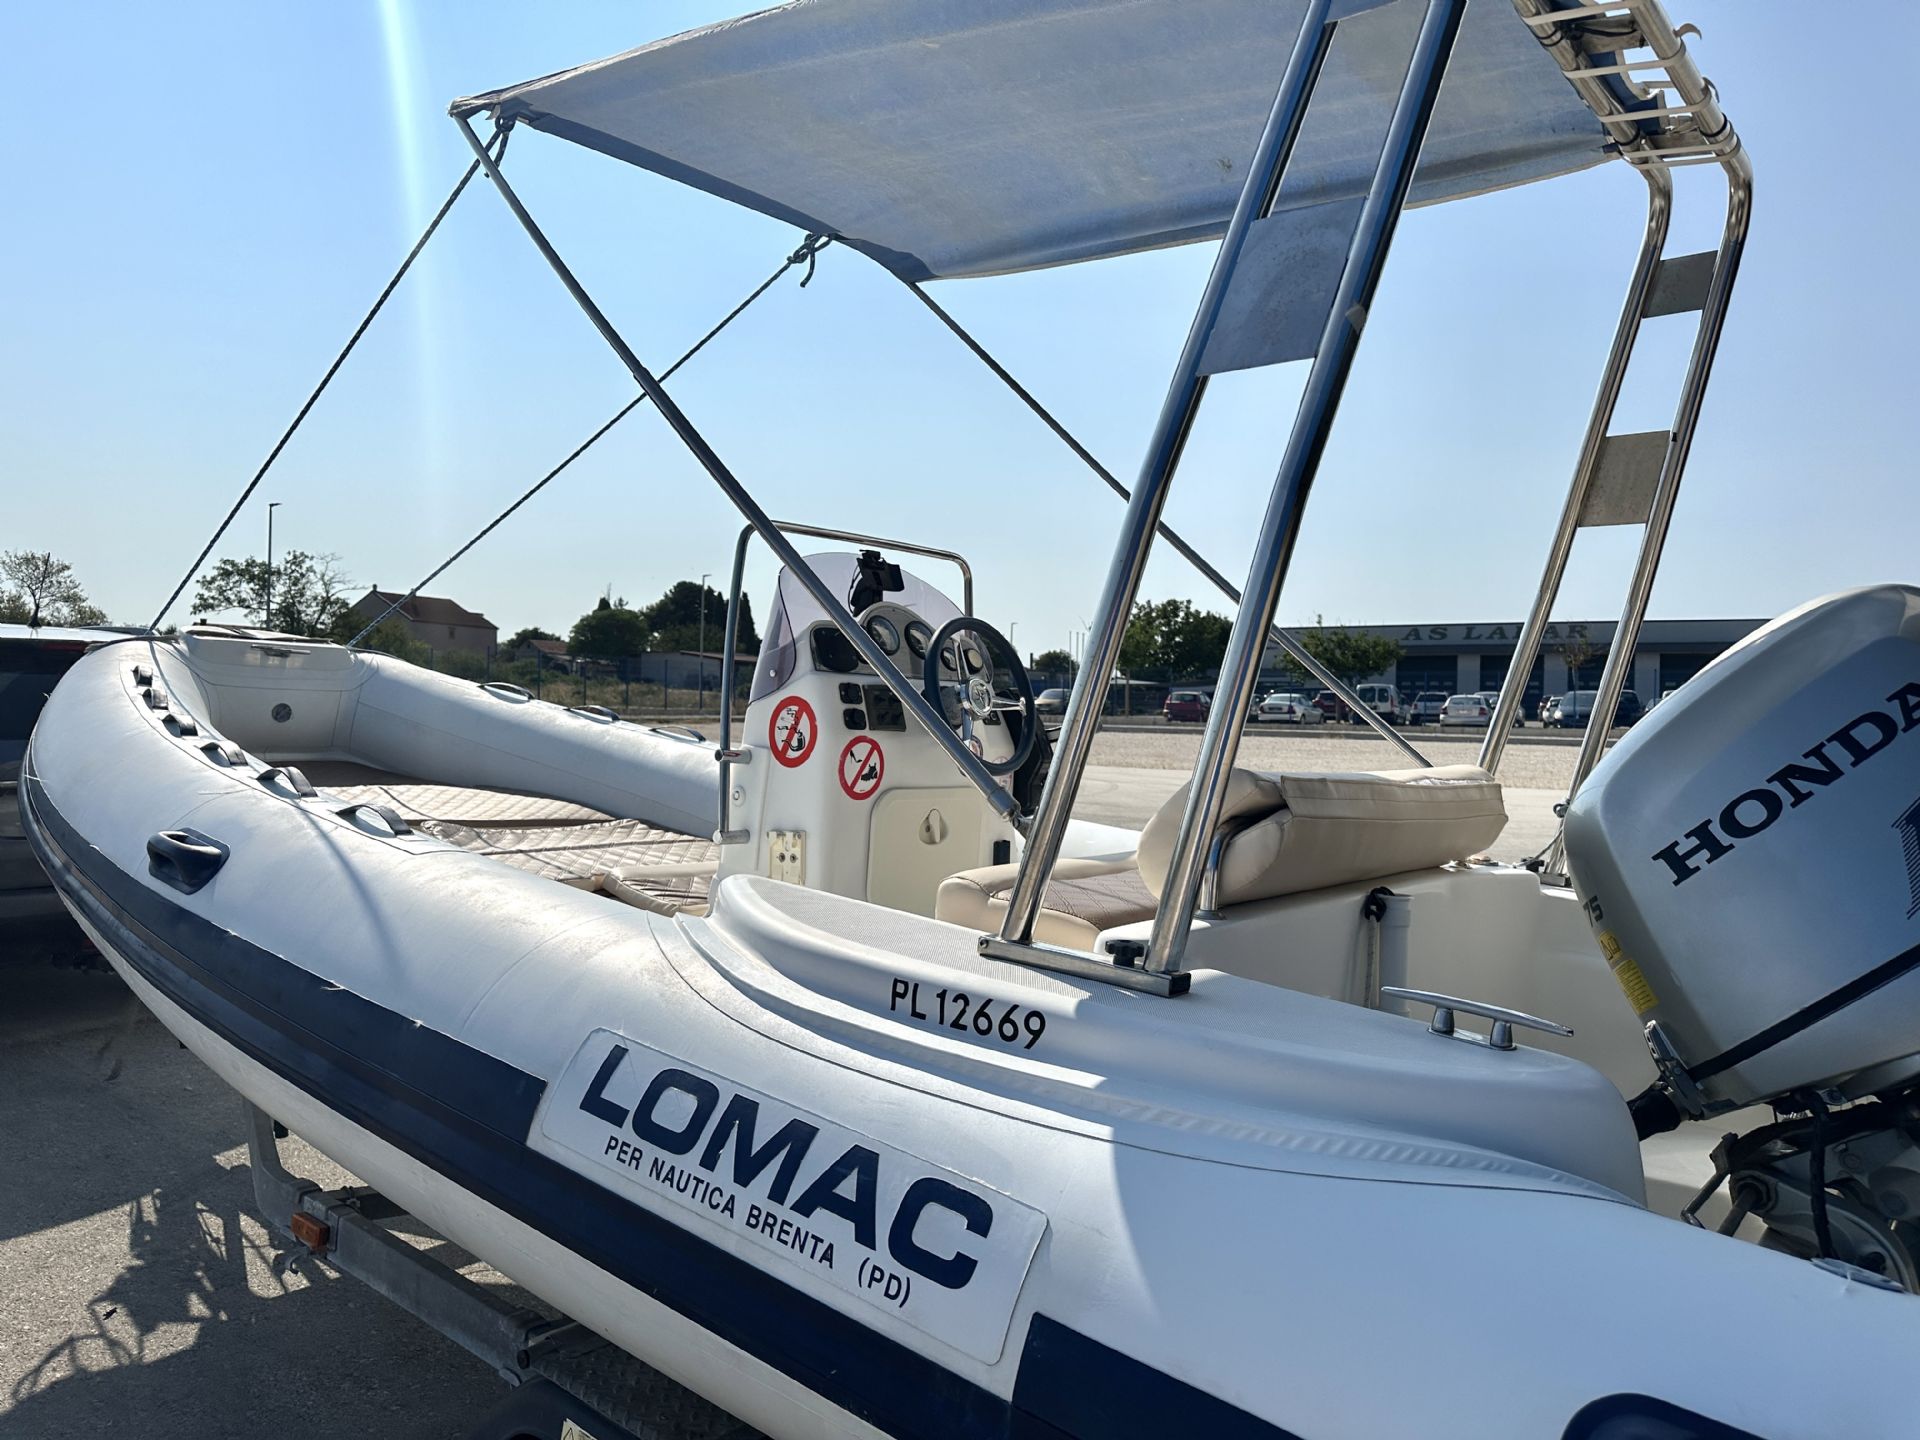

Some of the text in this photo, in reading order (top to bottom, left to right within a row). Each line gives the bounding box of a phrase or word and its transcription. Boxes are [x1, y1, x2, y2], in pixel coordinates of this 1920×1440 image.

[578, 1043, 994, 1290] LOMAC
[603, 1135, 912, 1309] PER NAUTICA BRENTA (PD)
